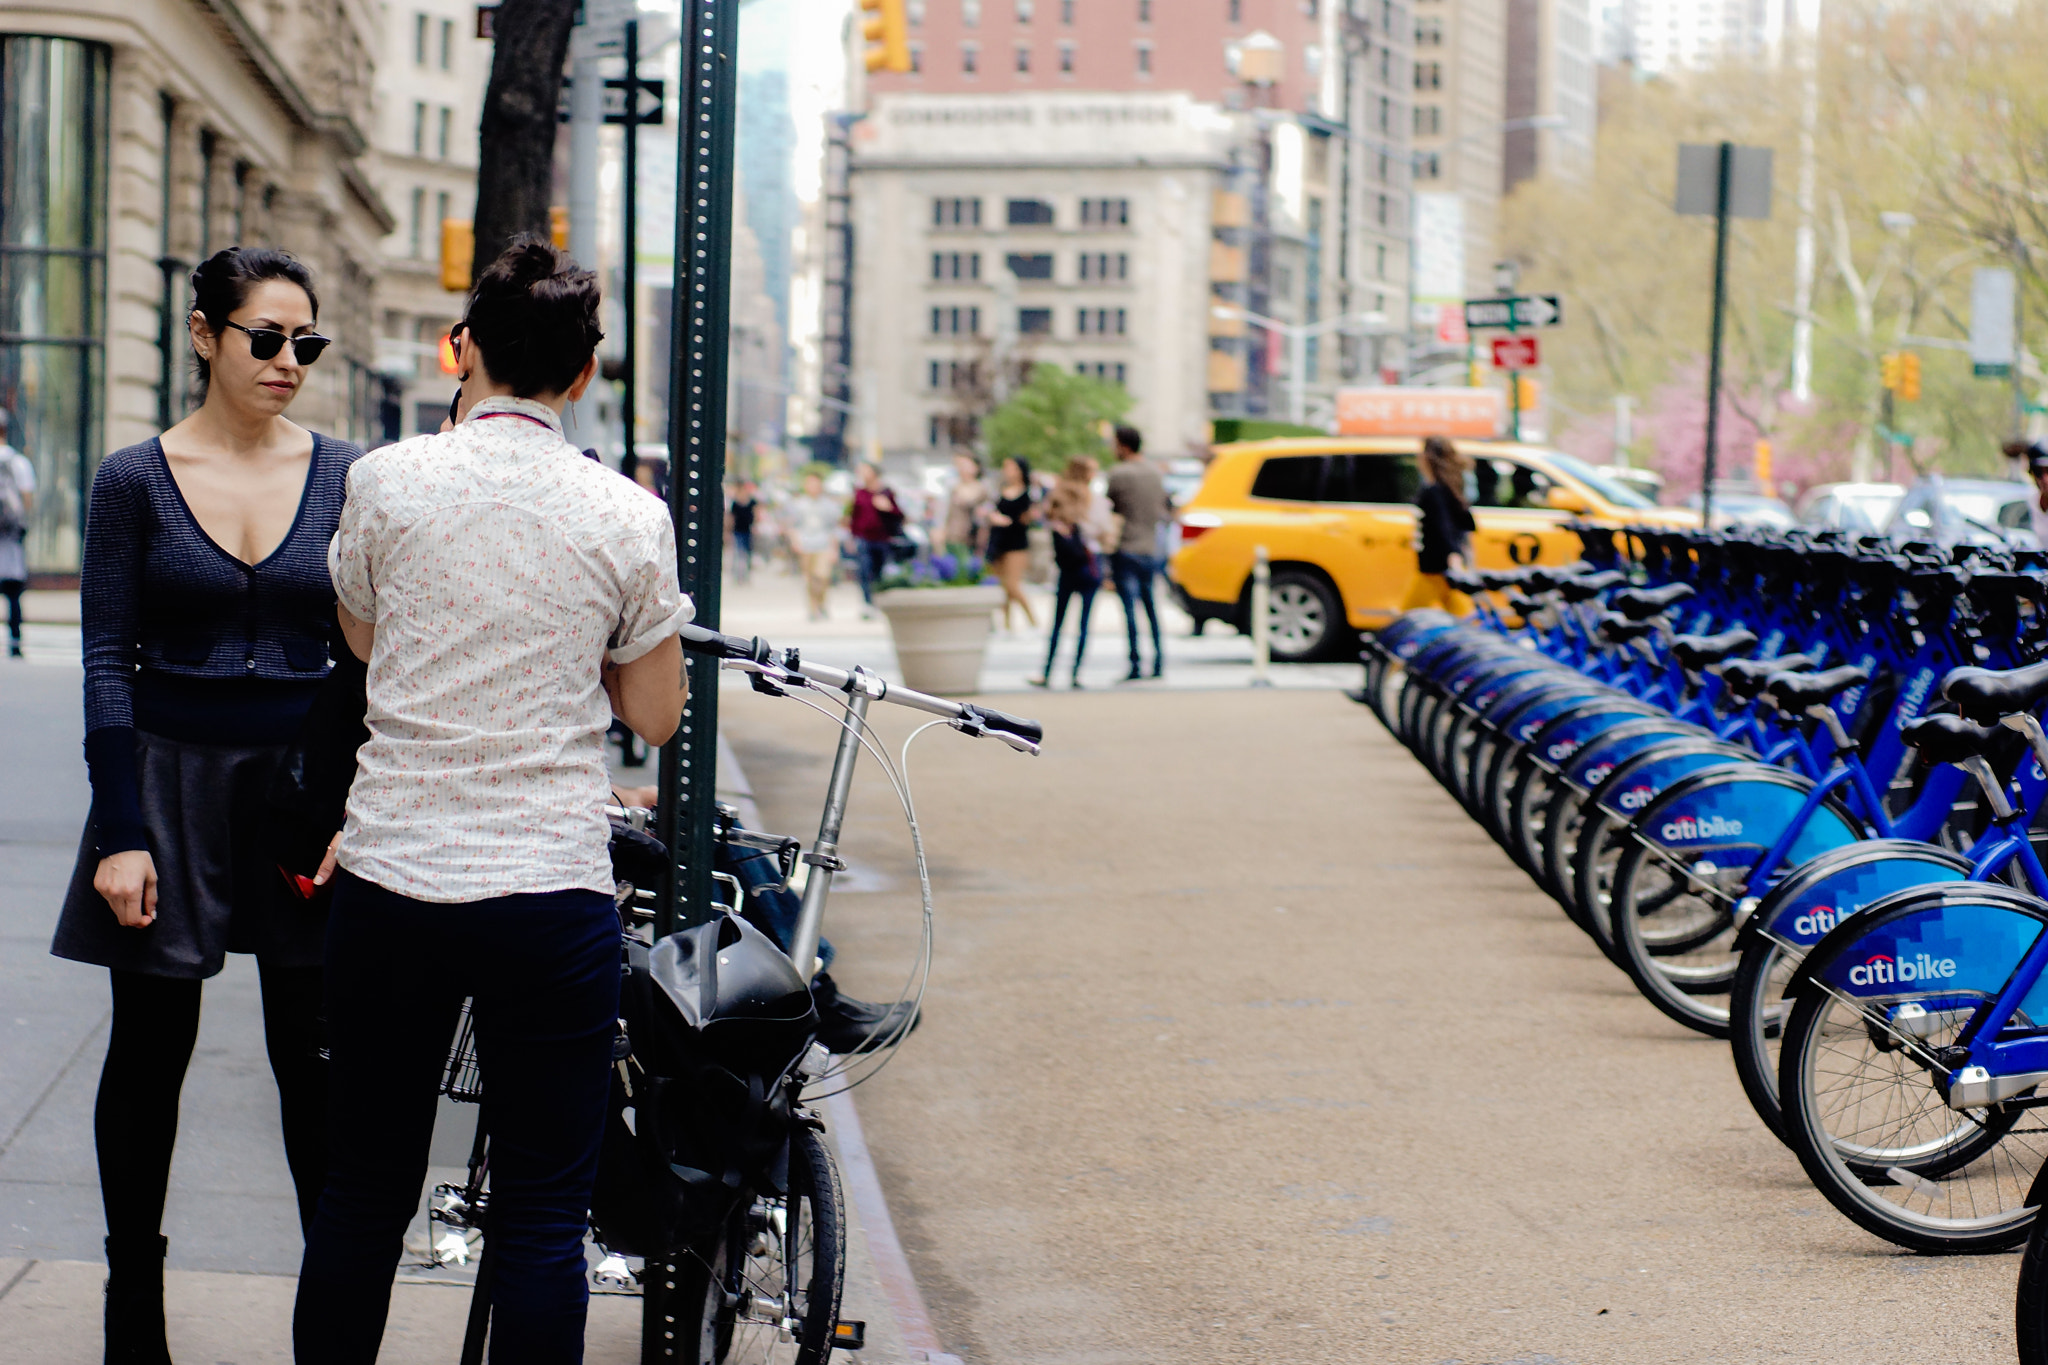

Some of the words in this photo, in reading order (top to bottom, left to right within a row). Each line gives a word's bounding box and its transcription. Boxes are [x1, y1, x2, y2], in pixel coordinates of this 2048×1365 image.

[1661, 817, 1697, 841] citi
[1697, 815, 1743, 839] bike
[1794, 906, 1835, 936] citi
[1849, 955, 1895, 986] citi
[1897, 953, 1957, 982] bike
